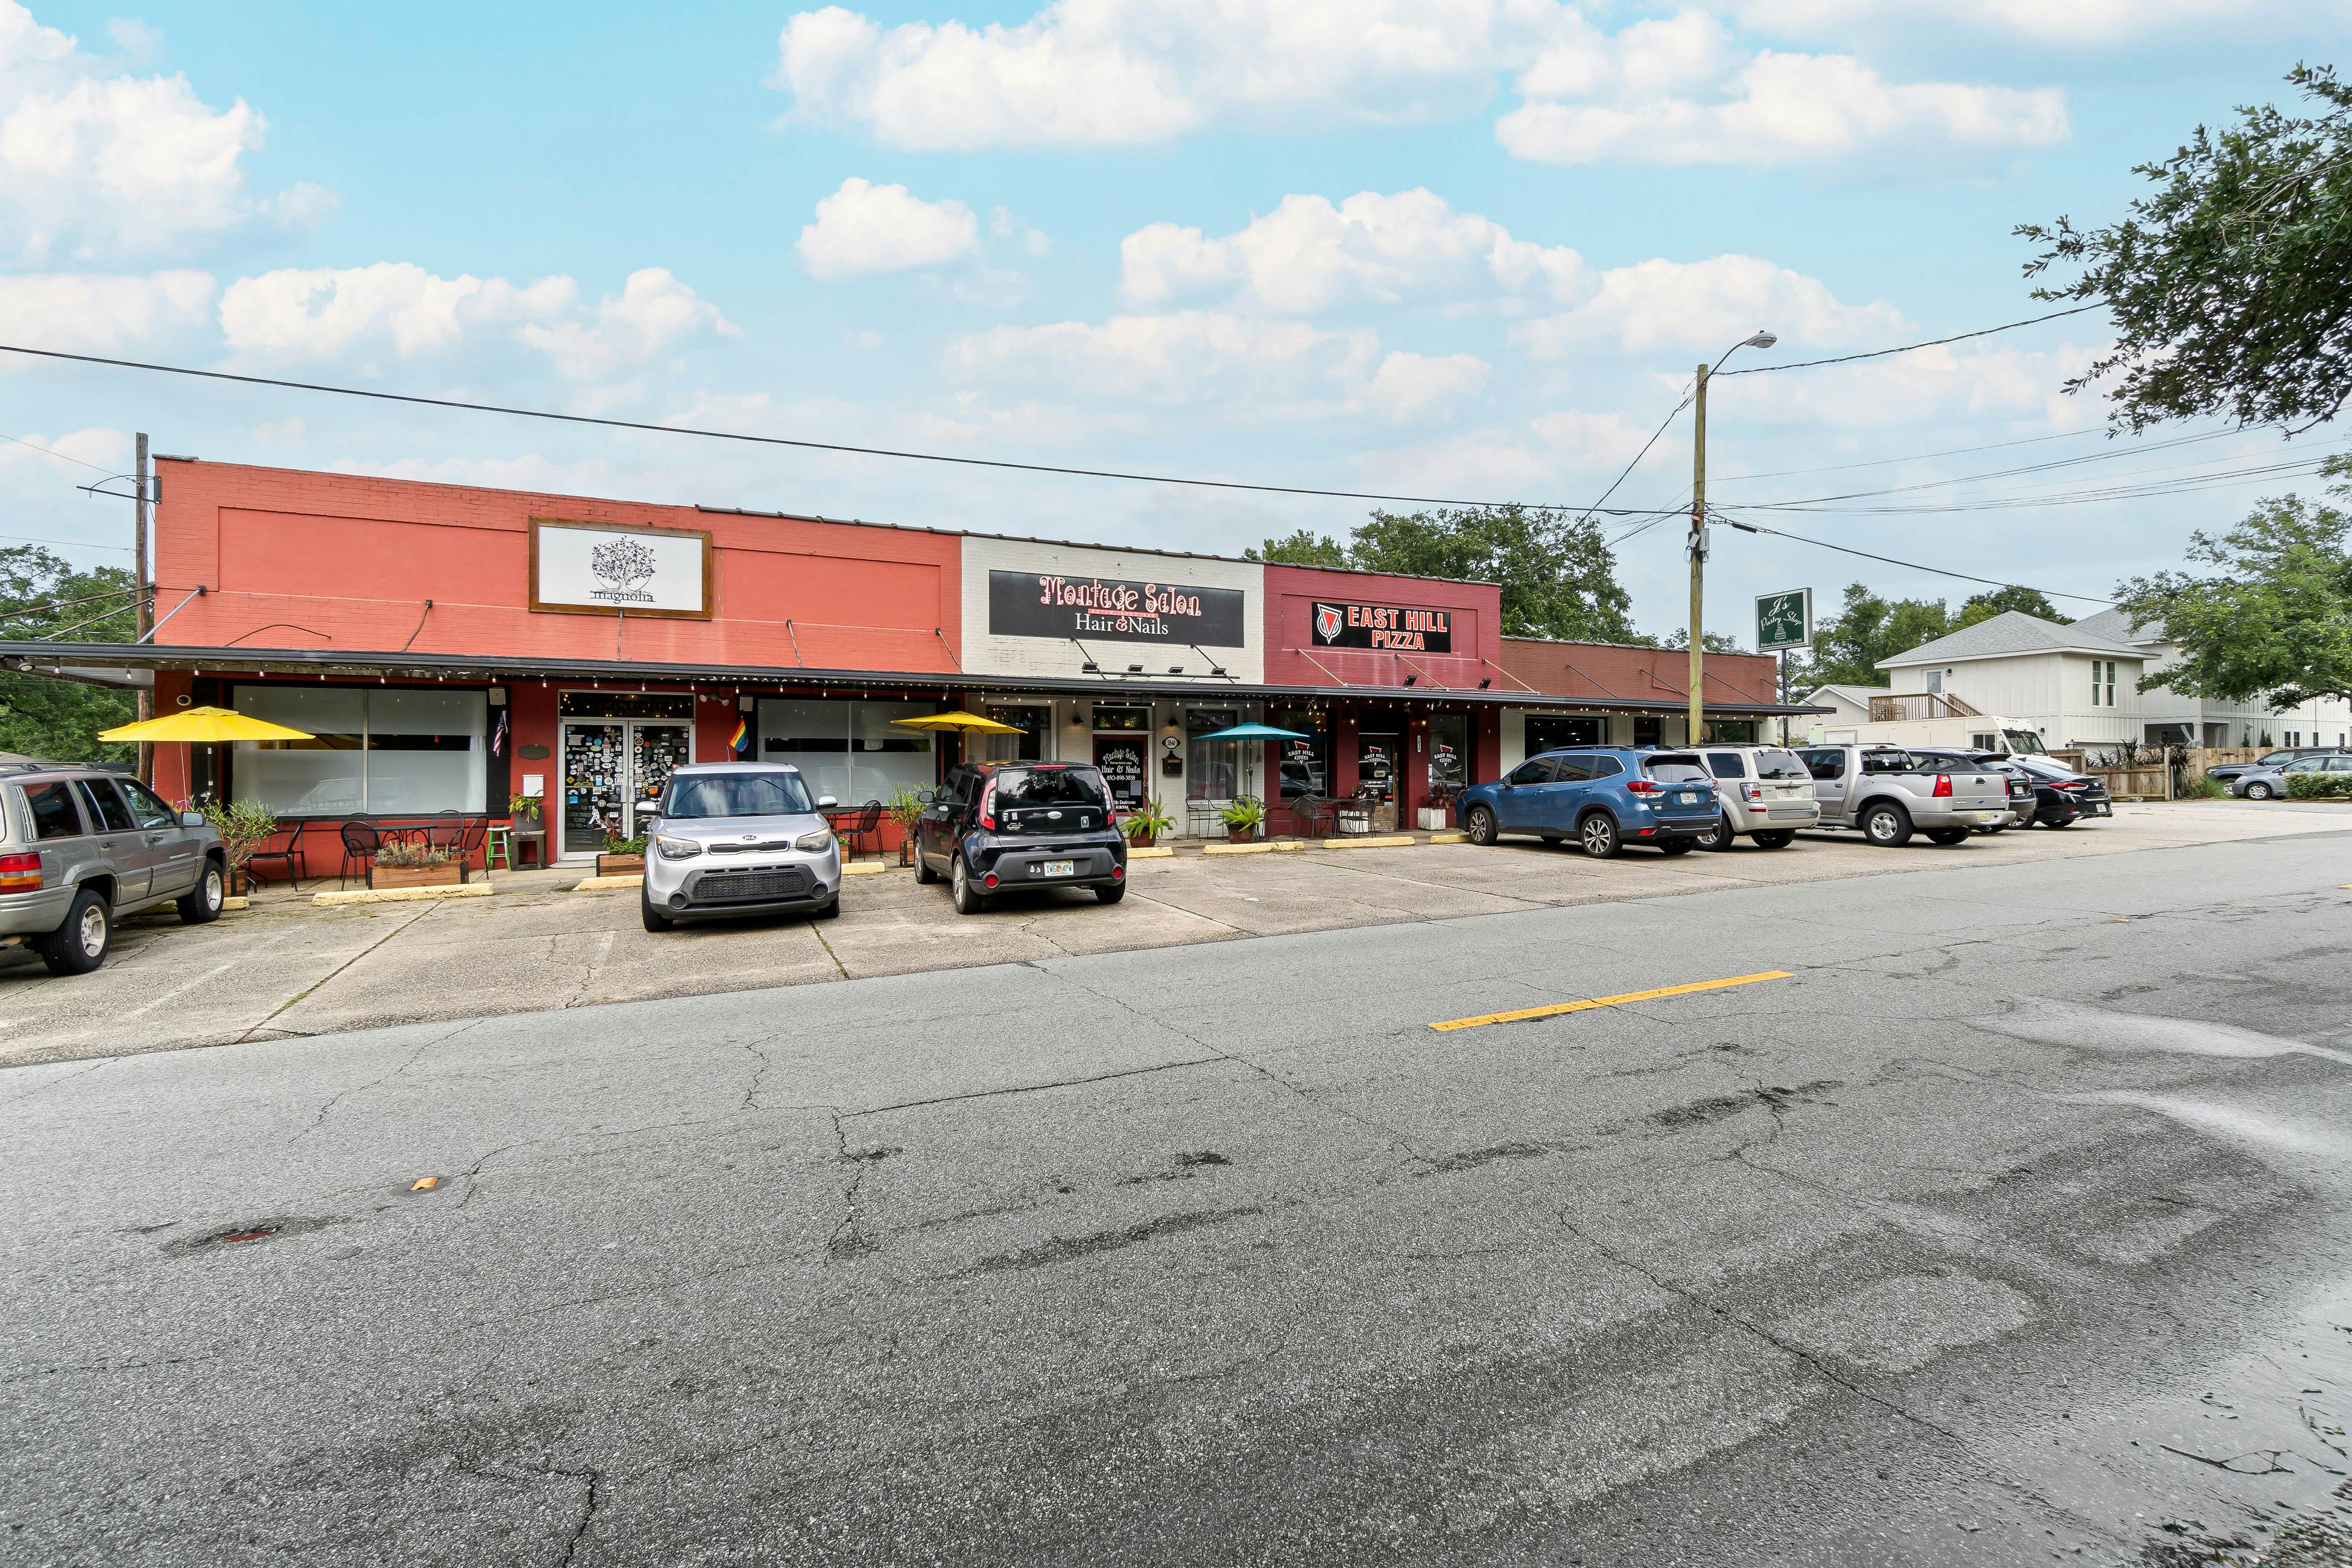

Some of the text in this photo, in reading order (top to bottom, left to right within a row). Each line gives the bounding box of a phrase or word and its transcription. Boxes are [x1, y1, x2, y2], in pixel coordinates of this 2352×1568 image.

[590, 590, 656, 604] magnolia
[1039, 576, 1201, 617] Montage Salon
[1768, 595, 1791, 617] J's
[1075, 613, 1169, 635] Hair & Nails
[1347, 606, 1447, 633] EAST HILL
[1760, 611, 1802, 631] Pastry Shop
[1372, 630, 1425, 650] PIZZA
[1102, 748, 1139, 765] Montage Salon
[1125, 765, 1140, 774] Nails
